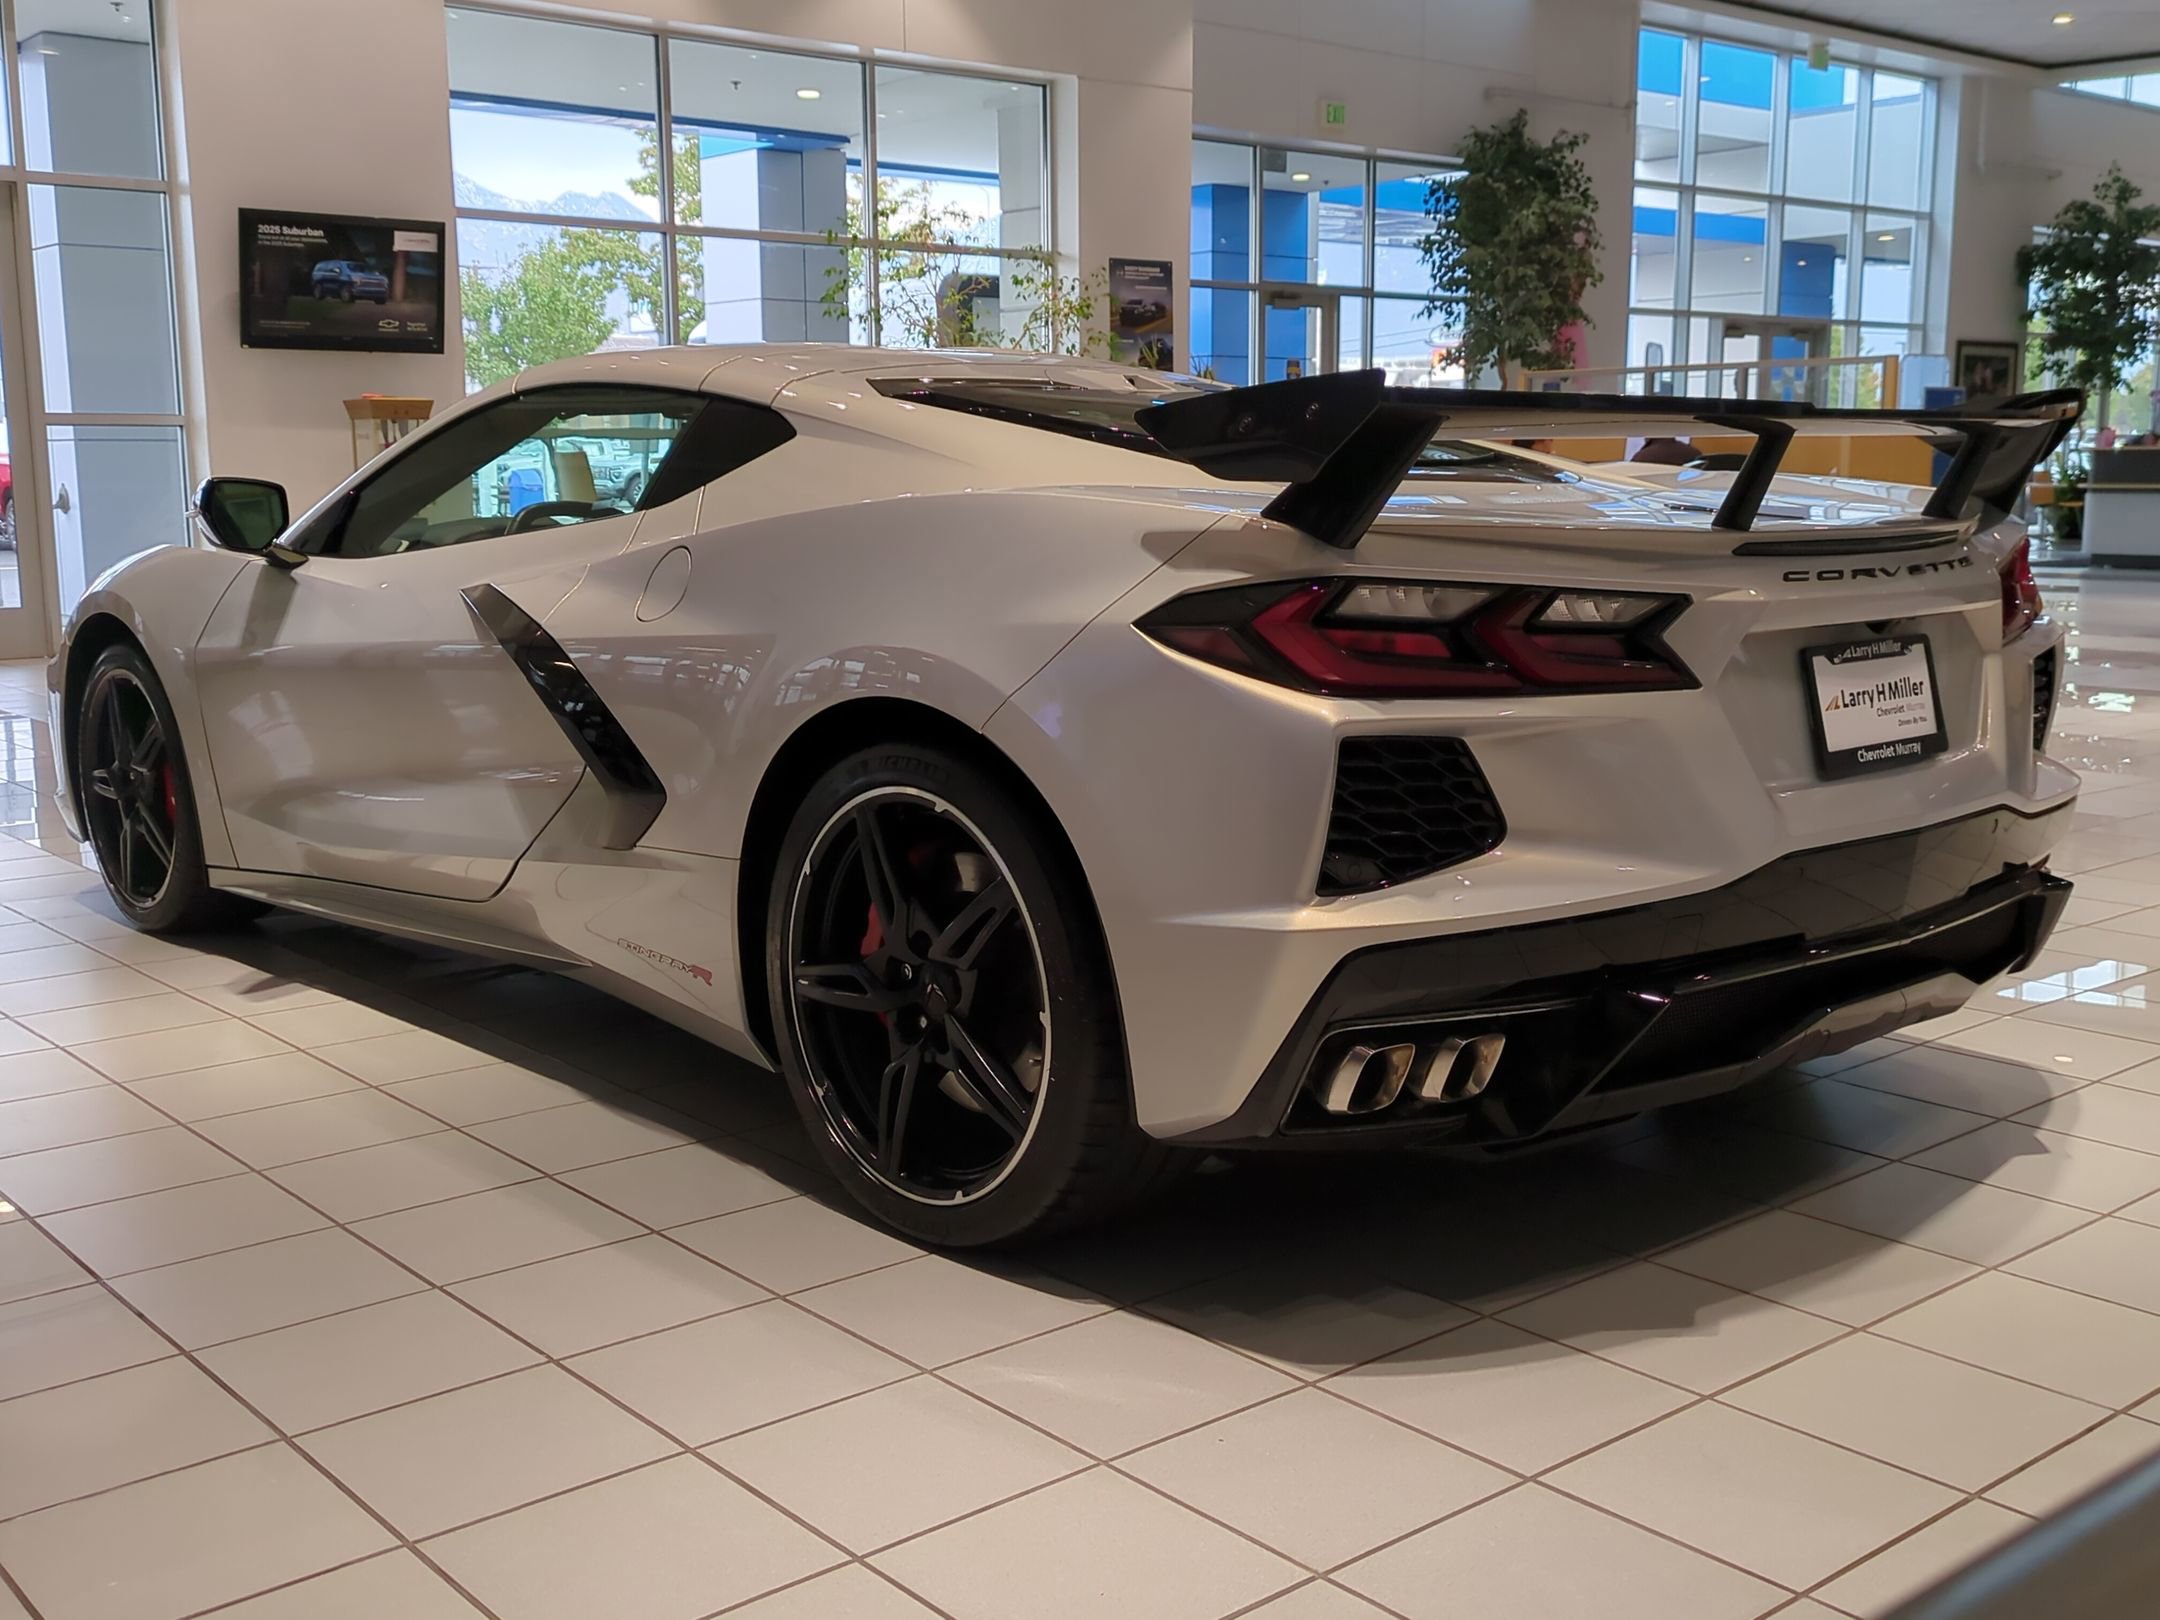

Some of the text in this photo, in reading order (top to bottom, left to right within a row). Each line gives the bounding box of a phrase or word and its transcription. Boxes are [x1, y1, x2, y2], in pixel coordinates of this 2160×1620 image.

[257, 224, 325, 237] 2025 Suburban
[1783, 556, 1974, 582] CORVETTE
[1851, 645, 1871, 658] Larry
[1872, 643, 1880, 654] H
[1841, 677, 1924, 708] Larry H Miller
[1876, 705, 1905, 717] Chevrolet
[1857, 743, 1921, 762] Chevrolet Murray
